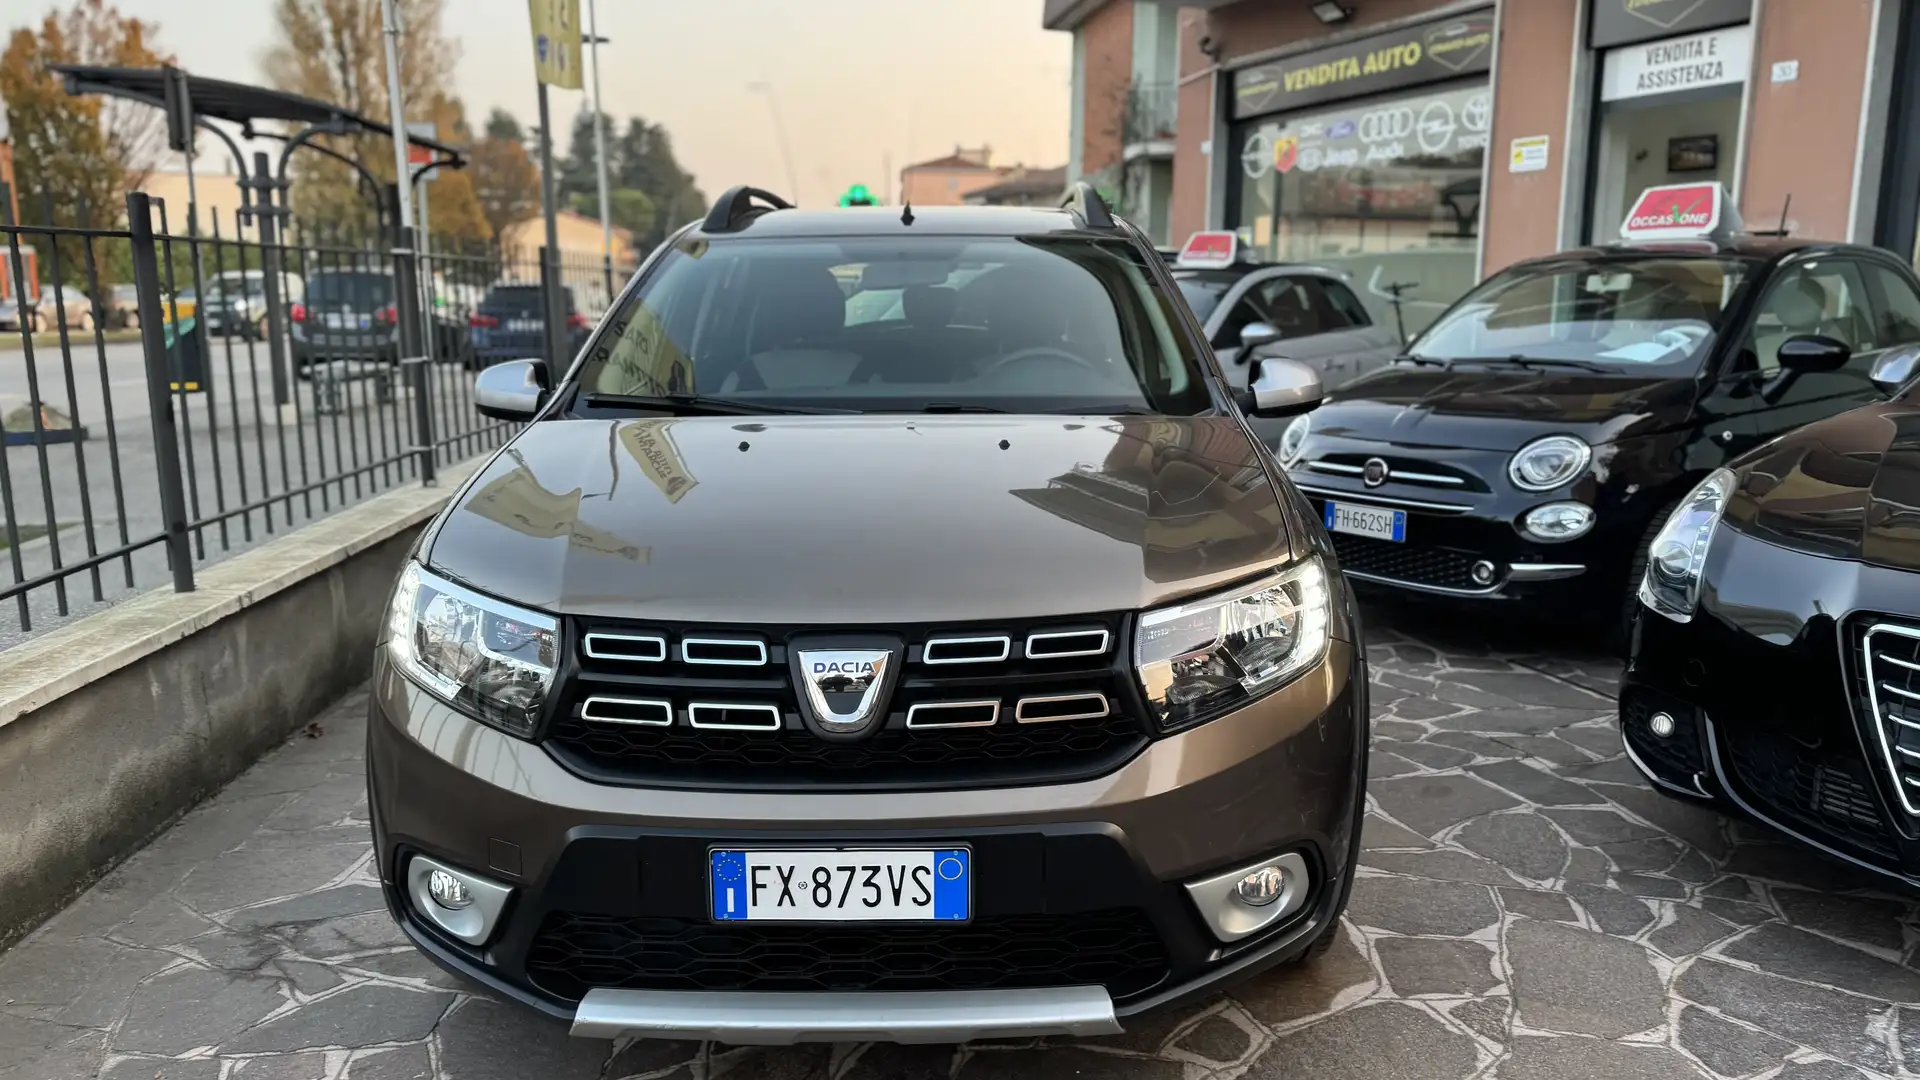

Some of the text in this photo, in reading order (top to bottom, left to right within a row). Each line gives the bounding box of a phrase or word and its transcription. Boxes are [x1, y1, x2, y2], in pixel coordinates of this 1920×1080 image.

[1646, 37, 1719, 66] VENDITA E
[1284, 58, 1361, 92] VENDITA
[1363, 42, 1422, 73] AUTO
[1636, 61, 1724, 91] ASSISTENZA
[1365, 141, 1404, 163] Audi
[1631, 210, 1708, 227] OCCASIONE
[813, 661, 876, 674] DACIA
